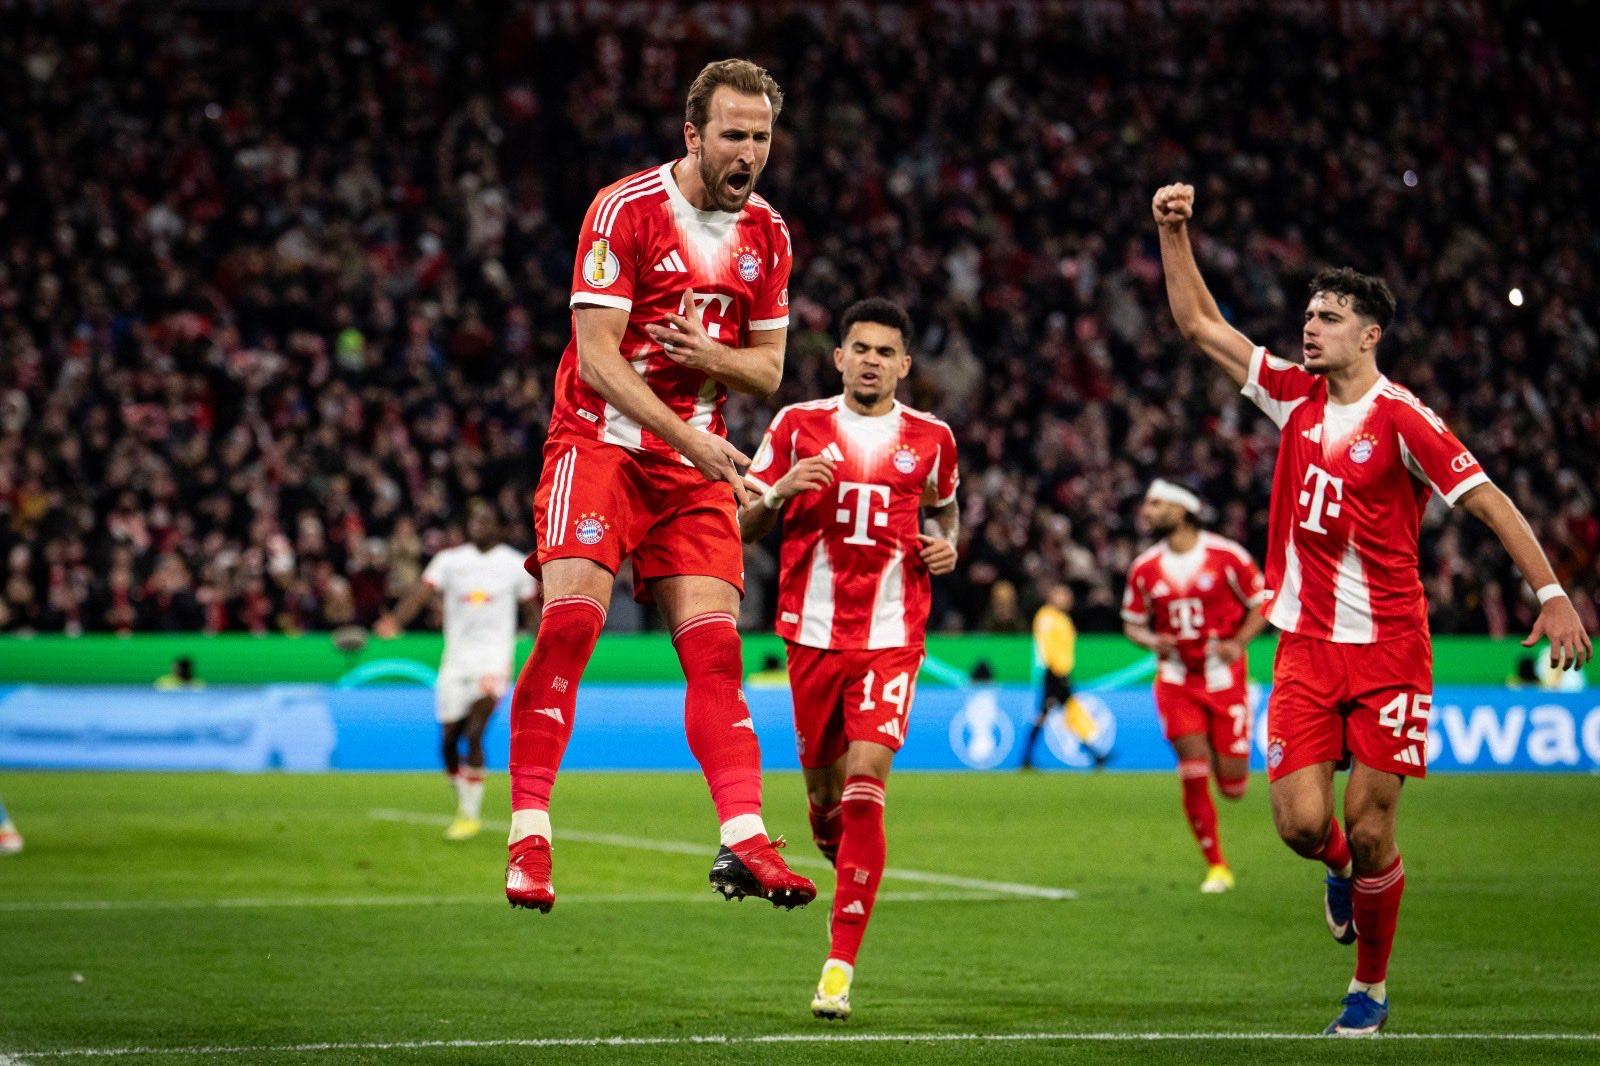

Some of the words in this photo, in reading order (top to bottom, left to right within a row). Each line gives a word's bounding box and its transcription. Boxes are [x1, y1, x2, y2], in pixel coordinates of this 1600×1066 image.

[836, 481, 891, 546] T
[1299, 463, 1343, 535] T
[1168, 597, 1205, 640] T
[859, 669, 909, 715] 14
[1379, 692, 1433, 742] 45
